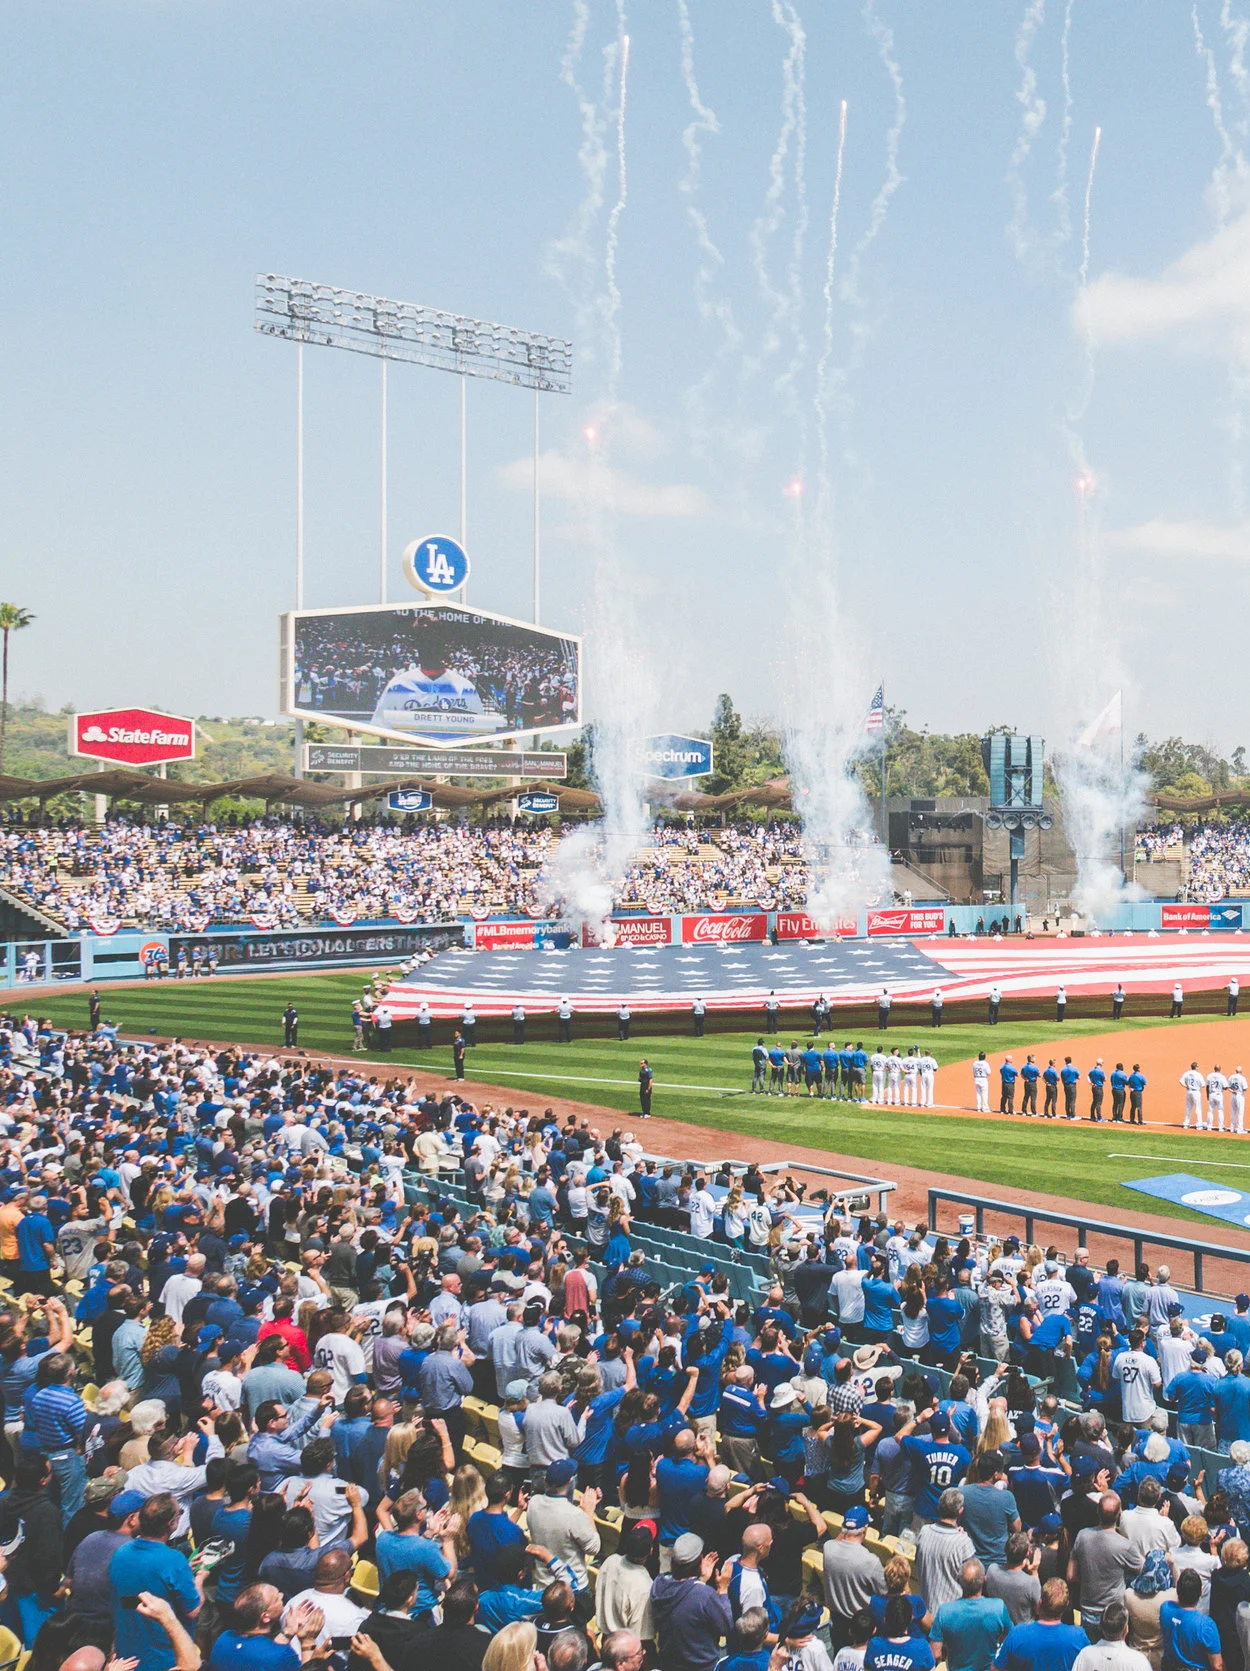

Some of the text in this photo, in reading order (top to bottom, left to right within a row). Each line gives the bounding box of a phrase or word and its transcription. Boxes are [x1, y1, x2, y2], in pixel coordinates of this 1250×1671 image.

[426, 543, 454, 585] LA
[392, 609, 409, 617] ND
[438, 612, 470, 623] HOME
[473, 616, 487, 625] OF
[446, 715, 475, 723] YOUNG
[910, 912, 944, 921] THIS BUD'S
[1163, 912, 1182, 920] Bank
[1191, 912, 1222, 920] America
[620, 922, 667, 934] MANUEL
[694, 917, 756, 940] Coca-Cola
[779, 919, 800, 934] Fly
[751, 1210, 762, 1222] 42
[62, 1238, 84, 1256] 23
[1044, 1294, 1060, 1309] 22
[1125, 1357, 1137, 1365] KEMP
[1122, 1366, 1140, 1384] 27
[926, 1452, 958, 1466] TURNER
[929, 1465, 952, 1486] 10
[874, 1654, 913, 1670] SEAGER
